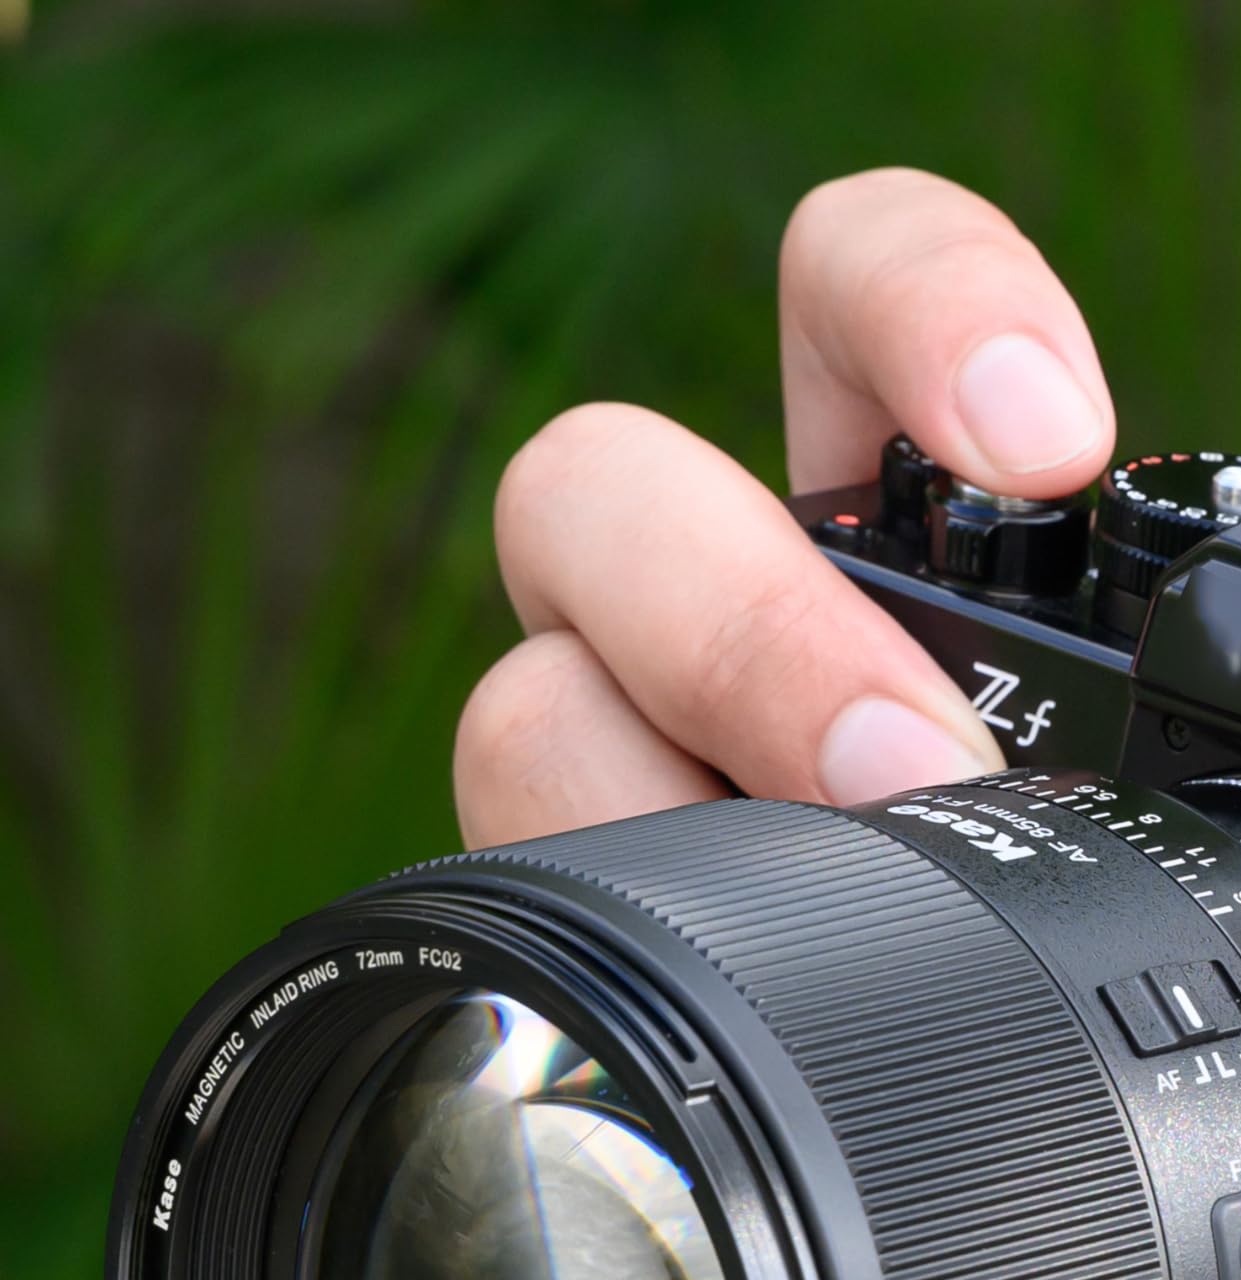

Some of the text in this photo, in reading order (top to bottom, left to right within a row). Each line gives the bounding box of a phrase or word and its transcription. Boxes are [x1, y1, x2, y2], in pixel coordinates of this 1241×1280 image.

[1073, 785, 1118, 801] 5.6
[973, 803, 1055, 839] 85mm
[1138, 813, 1163, 825] 8
[887, 804, 1037, 862] Kase
[1048, 841, 1098, 863] AF
[1184, 846, 1217, 868] 11
[153, 947, 462, 1231] Kase MAGNETIC INLAID RING 72mm FC02
[1156, 1069, 1182, 1093] AF
